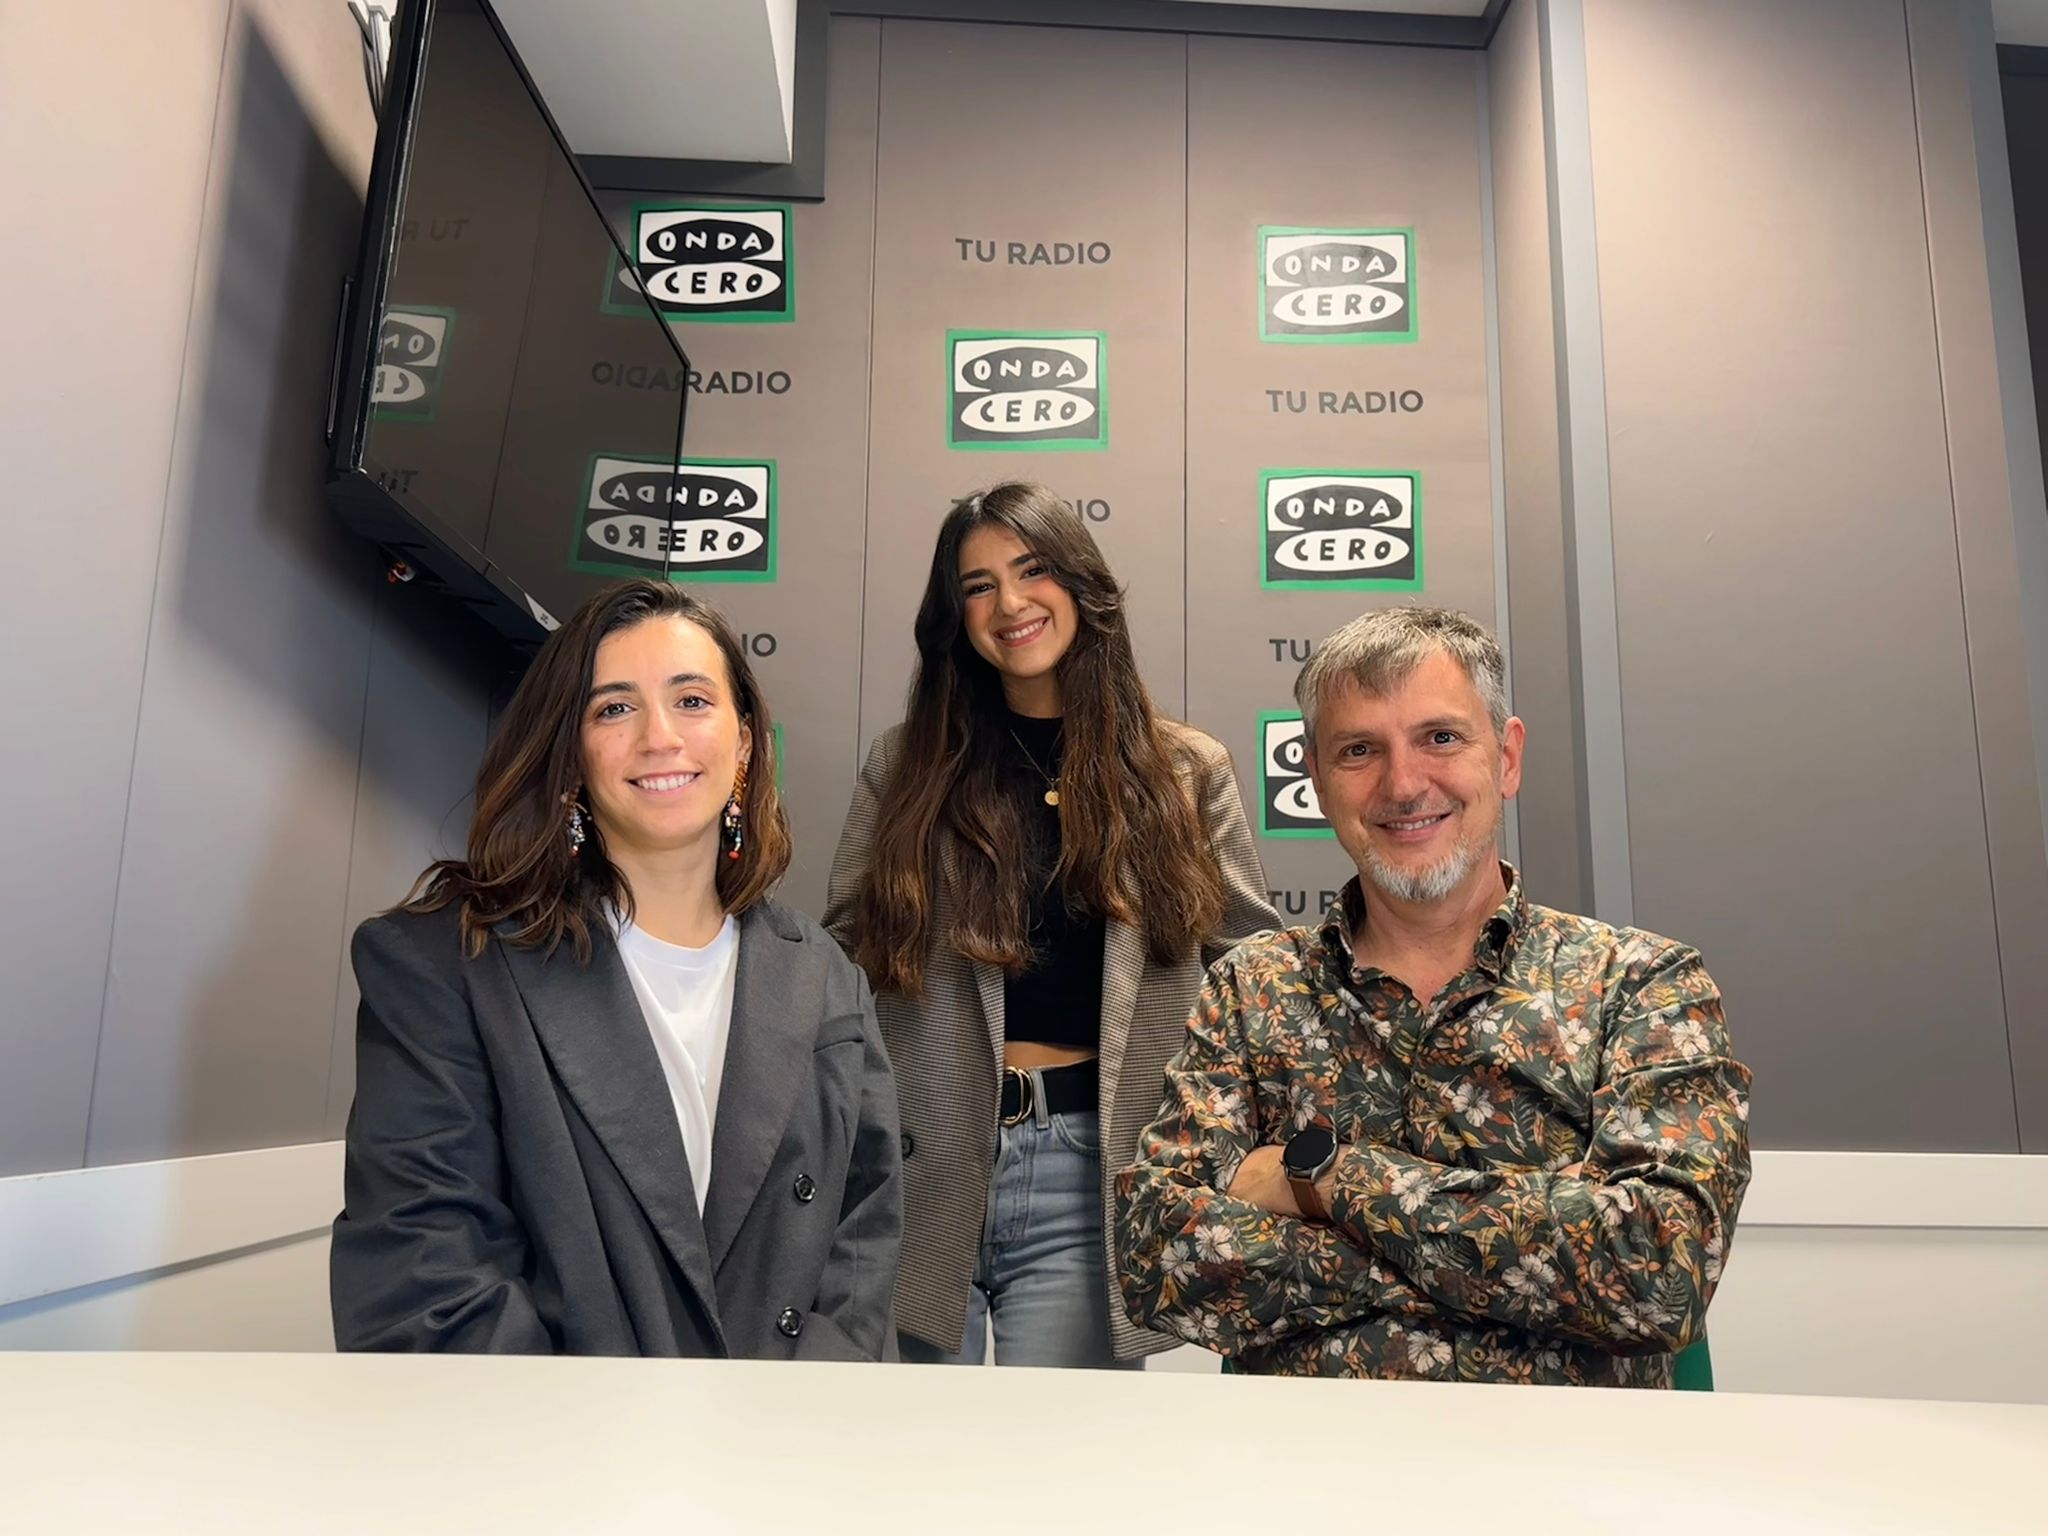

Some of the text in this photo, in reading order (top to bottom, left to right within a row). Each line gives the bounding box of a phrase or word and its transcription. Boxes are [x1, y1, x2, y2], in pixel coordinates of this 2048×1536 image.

[658, 231, 763, 252] ONDA
[955, 238, 1111, 265] TU RADIO
[1284, 254, 1386, 276] ONDA
[664, 271, 763, 294] CERO
[1291, 294, 1387, 317] CERO
[973, 359, 1077, 381] ONDA
[687, 370, 792, 395] RADIO
[979, 399, 1077, 423] CERO
[1266, 390, 1424, 414] TU RADIO
[674, 486, 746, 507] NDA
[1286, 497, 1391, 520] ONDA
[671, 529, 745, 552] ERO
[1293, 538, 1392, 562] CERO
[1269, 639, 1311, 662] TU
[1266, 891, 1306, 915] TU
